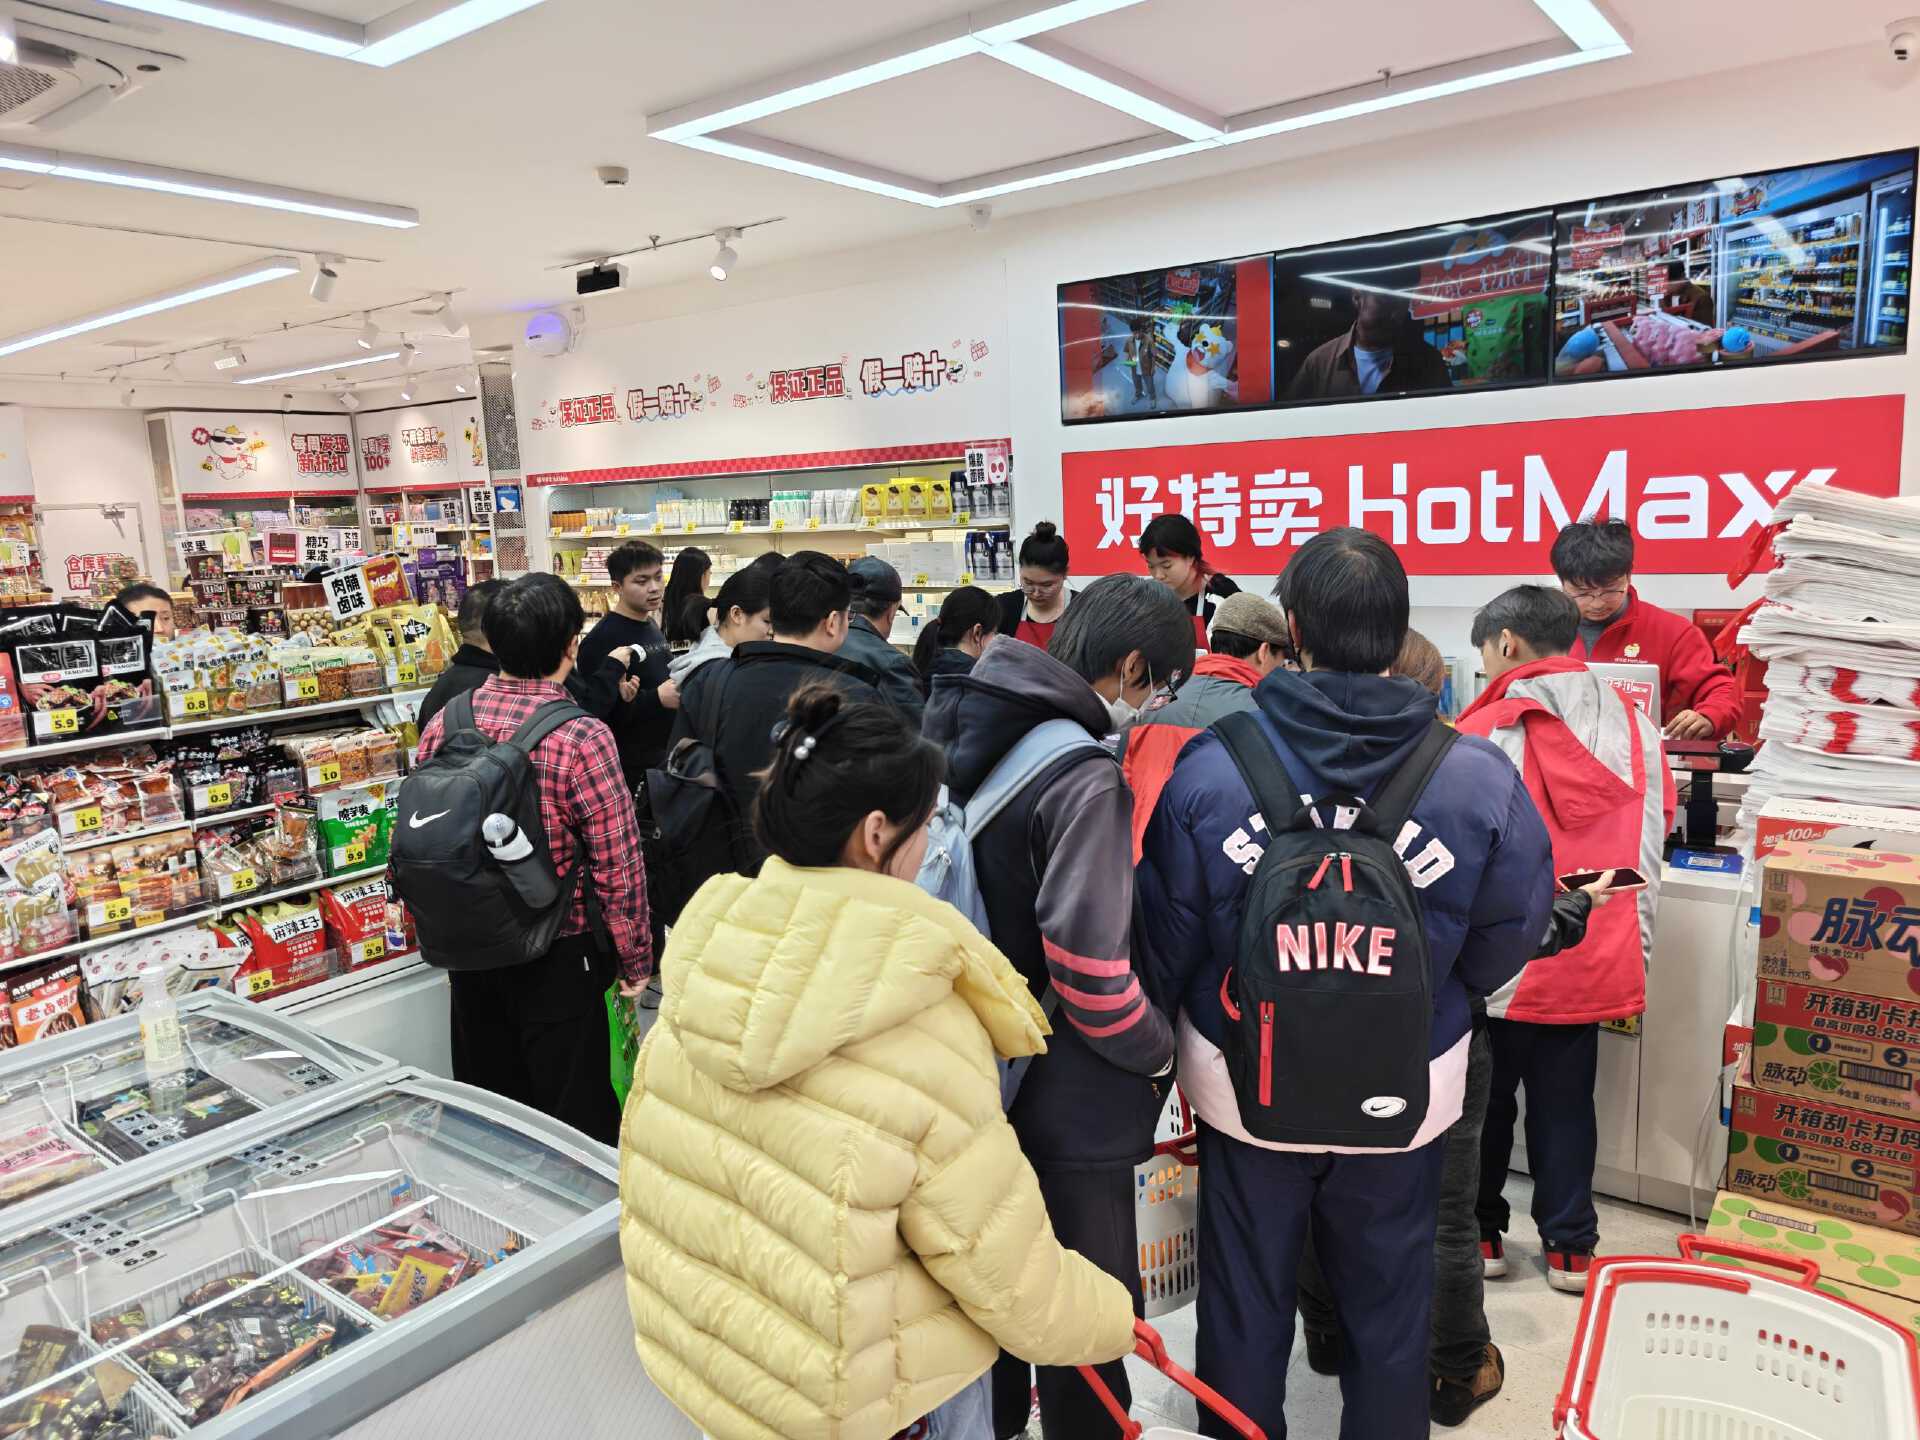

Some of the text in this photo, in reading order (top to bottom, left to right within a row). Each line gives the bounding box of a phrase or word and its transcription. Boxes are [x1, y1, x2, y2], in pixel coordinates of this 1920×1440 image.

[860, 350, 947, 394] 假一赔十
[769, 364, 845, 404] 保证正品
[559, 393, 616, 428] 保证正品
[627, 383, 691, 420] 假一赔十
[291, 433, 349, 453] 每周发现
[296, 452, 348, 473] 新折扣
[1096, 449, 1837, 549] 好特卖 HotMax
[181, 539, 209, 553] 坚果
[305, 550, 329, 563] 果冻
[370, 572, 399, 587] MEAT
[337, 592, 366, 615] 卤味
[187, 700, 206, 711] 0.8
[54, 718, 75, 730] 5.9
[322, 771, 338, 781] 1.0
[210, 792, 229, 803] 0.9
[79, 816, 98, 828] 1.8
[347, 850, 364, 861] 9.9
[107, 906, 129, 919] 6.9
[272, 915, 320, 940] 麻辣王子
[365, 945, 382, 957] 9.9
[1275, 921, 1397, 976] NIKE
[252, 979, 271, 992] 9.9
[1762, 1062, 1807, 1087] 脉动
[1782, 1127, 1913, 1163] 最高可得8.88元红包
[1734, 1168, 1777, 1193] 脉动
[123, 1249, 158, 1267] 6.9
